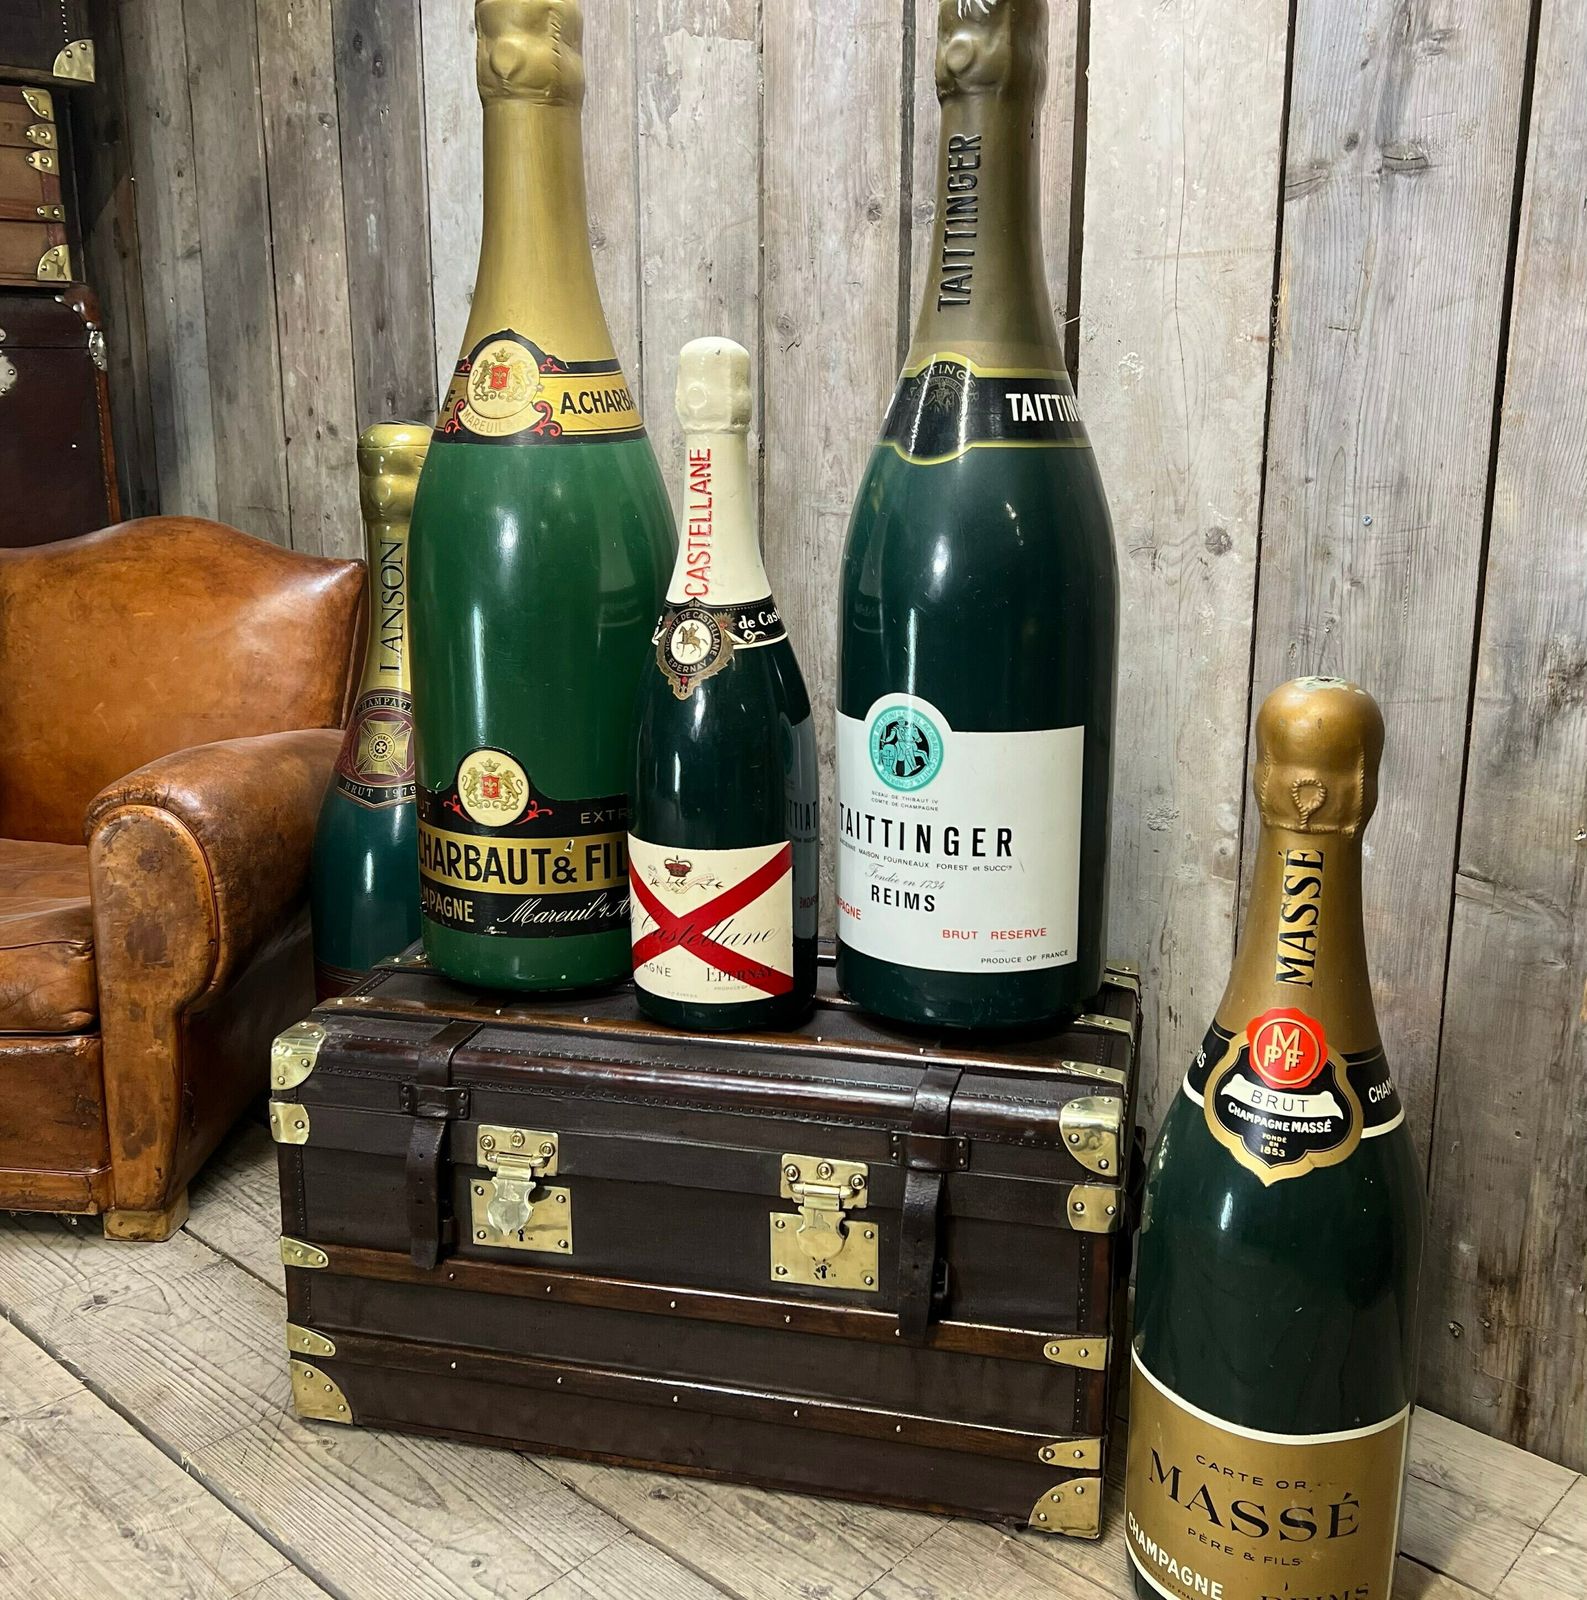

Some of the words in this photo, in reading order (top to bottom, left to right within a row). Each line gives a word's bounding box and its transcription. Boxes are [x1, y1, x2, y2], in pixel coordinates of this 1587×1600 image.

[937, 133, 982, 312] TAITTINGER
[684, 448, 713, 598] CASTELLANE
[379, 539, 405, 672] LANSON
[665, 617, 681, 653] VICOMTE
[681, 611, 691, 621] DE
[692, 611, 721, 657] CASTELLANE
[738, 615, 756, 630] de
[668, 658, 707, 673] EPERNAY
[344, 781, 374, 798] BRUT
[384, 785, 417, 798] 1979
[871, 797, 889, 806] COMTE
[900, 803, 939, 812] CHAMPAGNE
[839, 802, 1013, 858] TAITTINGER
[551, 856, 577, 885] &
[858, 849, 880, 860] MAISON
[883, 855, 929, 868] FOURNEAUX
[936, 863, 968, 871] FOREST
[871, 884, 935, 912] REIMS
[903, 879, 916, 887] en
[919, 879, 945, 890] 1734
[497, 892, 607, 927] Mareuil
[942, 929, 979, 940] BRUT
[990, 927, 1047, 940] RESERVE
[980, 956, 1022, 964] PRODUCE
[1041, 949, 1069, 960] FRANCE
[1250, 1089, 1309, 1113] BRUT
[1227, 1101, 1290, 1132] CHAMPAGNE
[1260, 1144, 1286, 1157] 1853
[1195, 1454, 1264, 1486] CARTE
[1148, 1446, 1360, 1543] MASSÉ
[1128, 1511, 1224, 1600] CHAMPAGNE
[1187, 1527, 1234, 1556] PÈRE
[1243, 1551, 1255, 1562] &
[1263, 1555, 1301, 1567] FILS
